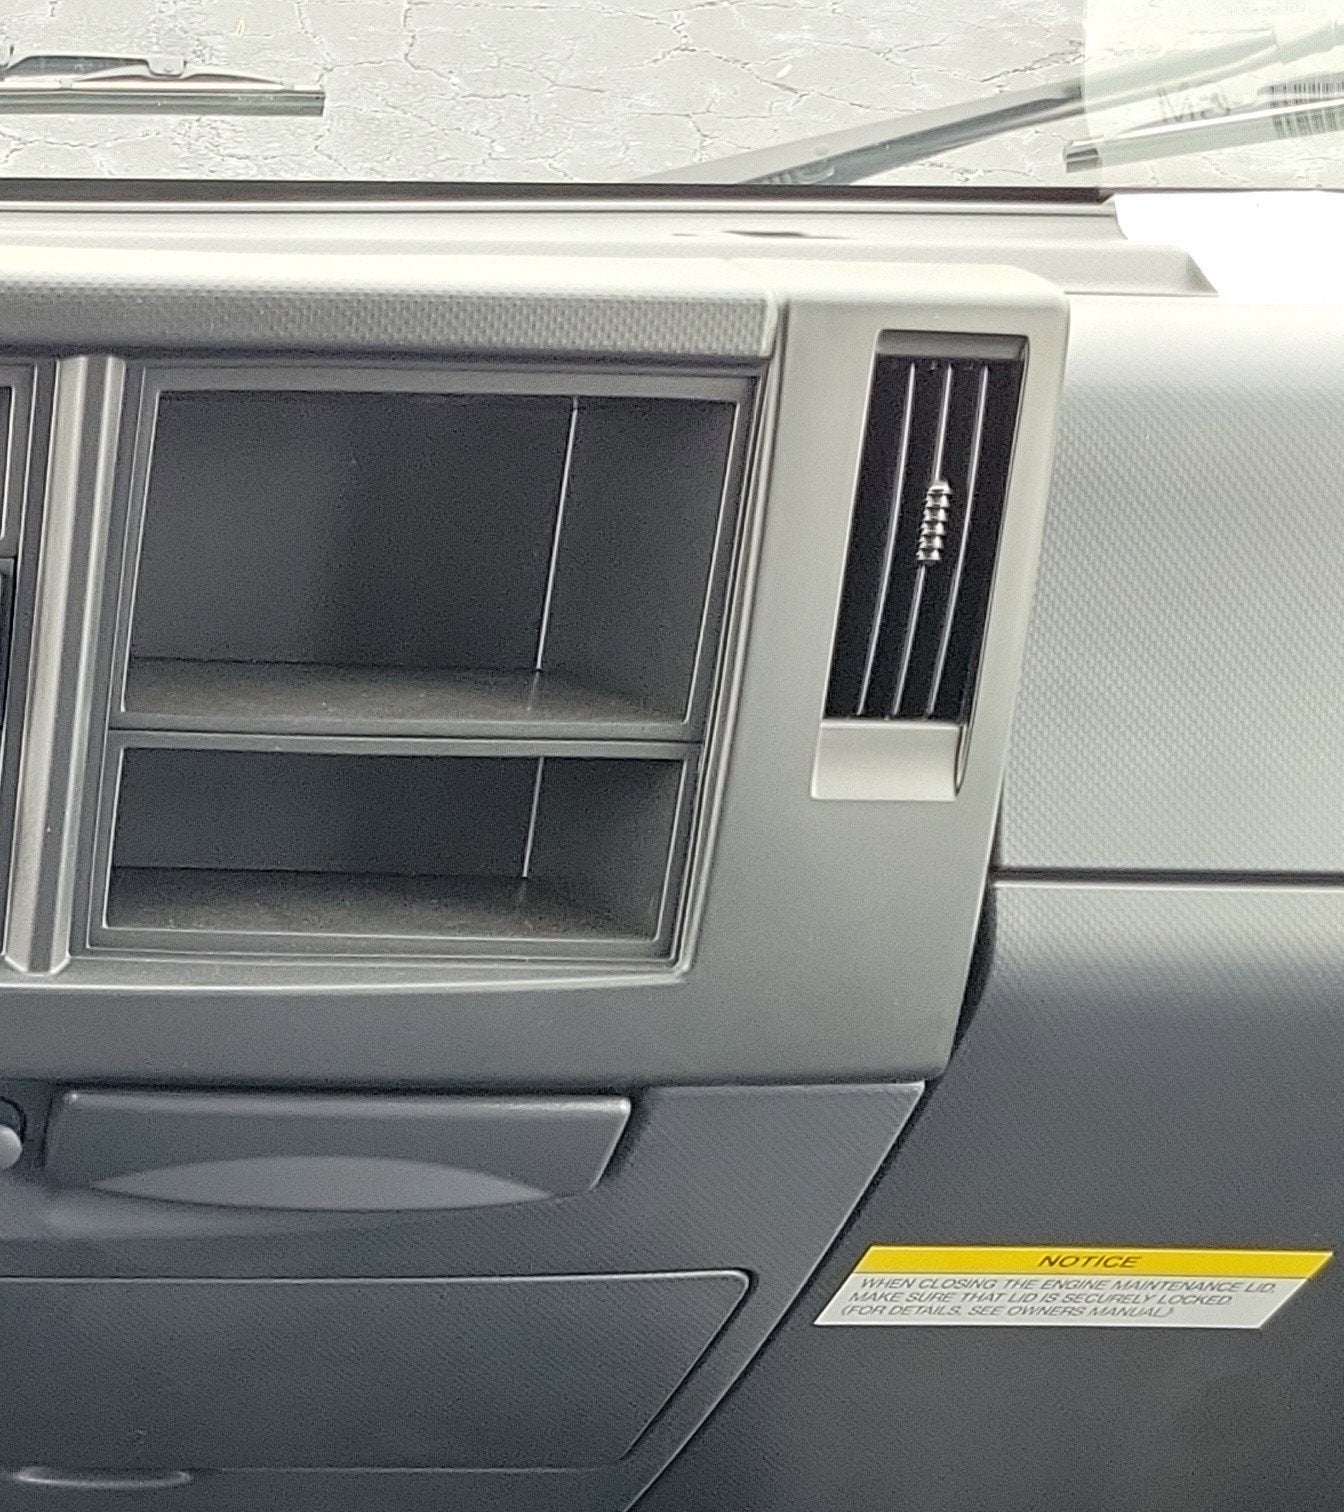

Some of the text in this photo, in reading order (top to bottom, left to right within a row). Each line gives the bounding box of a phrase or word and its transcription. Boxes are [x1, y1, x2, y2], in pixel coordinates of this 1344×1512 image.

[1037, 1255, 1141, 1269] NOTICE
[862, 1277, 916, 1289] WHEN
[918, 1278, 996, 1290] CLOSING
[1003, 1279, 1041, 1290] THE
[1040, 1279, 1111, 1291] ENGINE
[1112, 1280, 1244, 1292] MAINTENANCE
[849, 1291, 906, 1302] MAKE
[908, 1291, 957, 1302] SURE
[962, 1292, 1007, 1303] THAT
[1011, 1292, 1043, 1303] LID
[1042, 1293, 1061, 1304] IS
[1061, 1293, 1158, 1305] SECURELY
[840, 1305, 886, 1317] (FOR
[967, 1306, 1006, 1317] SEE
[1007, 1306, 1086, 1318] OWNERS
[1090, 1307, 1175, 1319] MANUAL)
